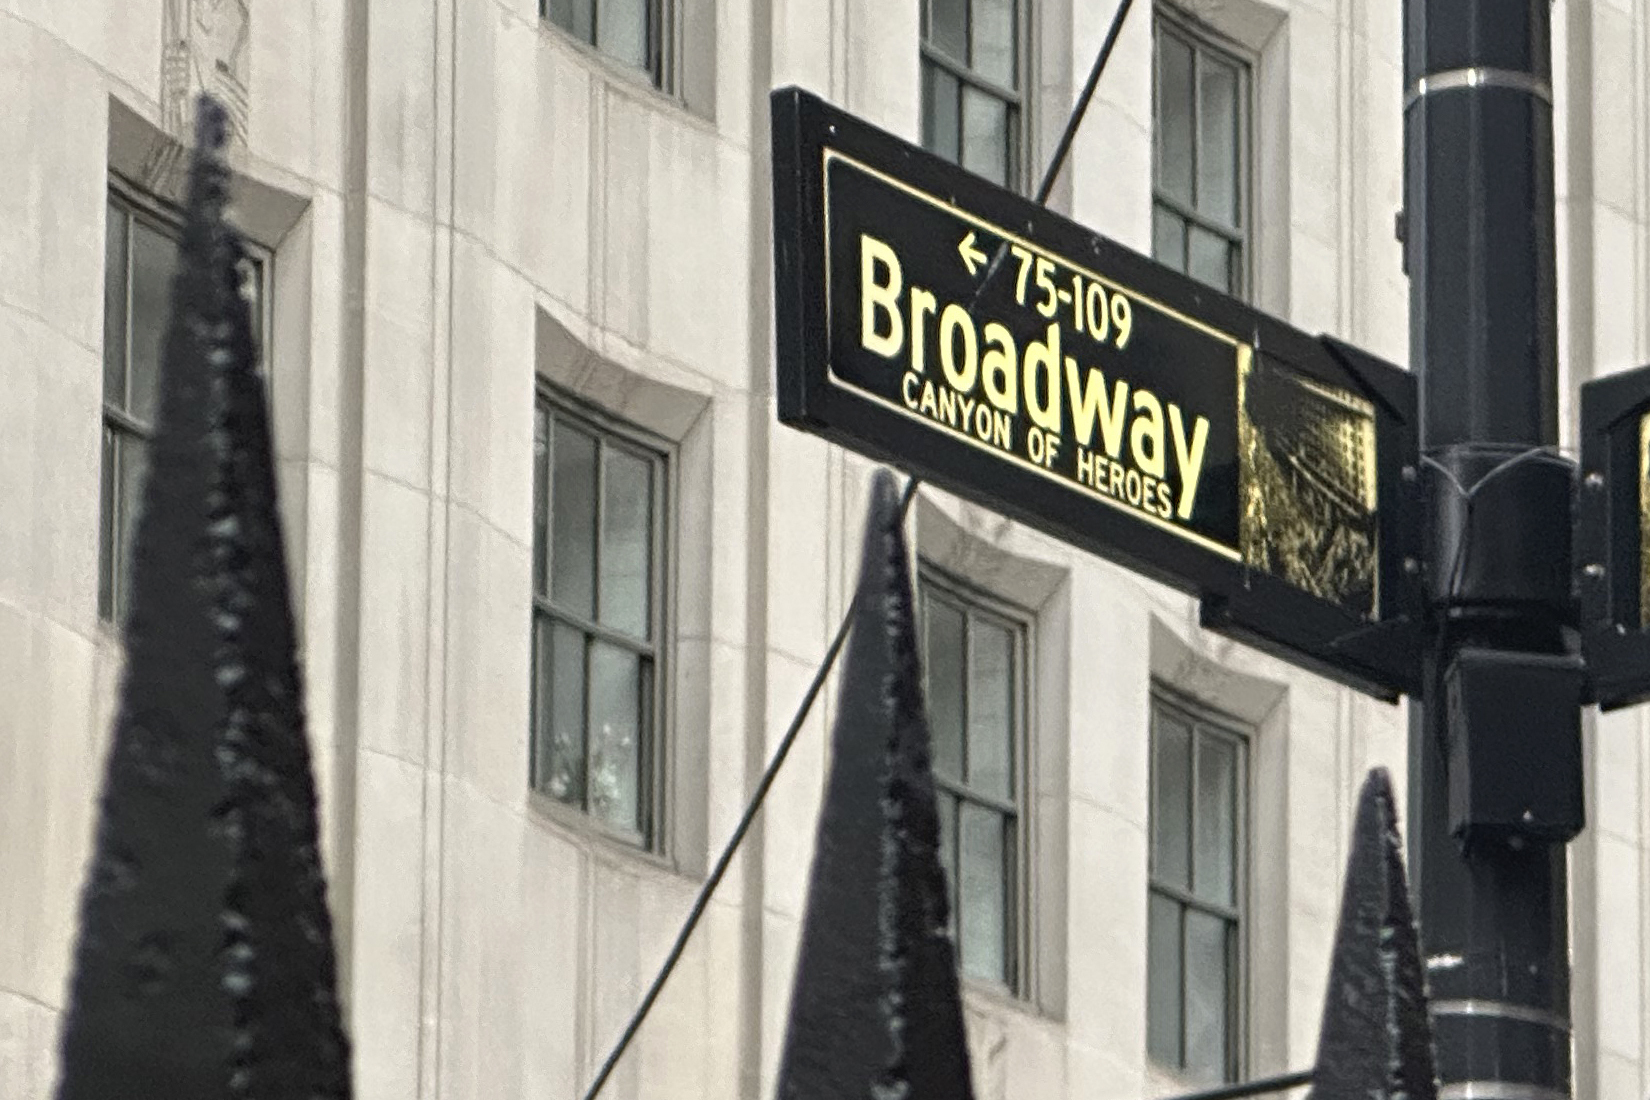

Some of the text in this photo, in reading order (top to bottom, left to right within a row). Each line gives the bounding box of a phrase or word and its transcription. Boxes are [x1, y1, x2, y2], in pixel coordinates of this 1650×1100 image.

[1012, 247, 1133, 349] 75-109
[861, 234, 1209, 520] Broadway
[902, 371, 1174, 519] CANYON OF HEROES
